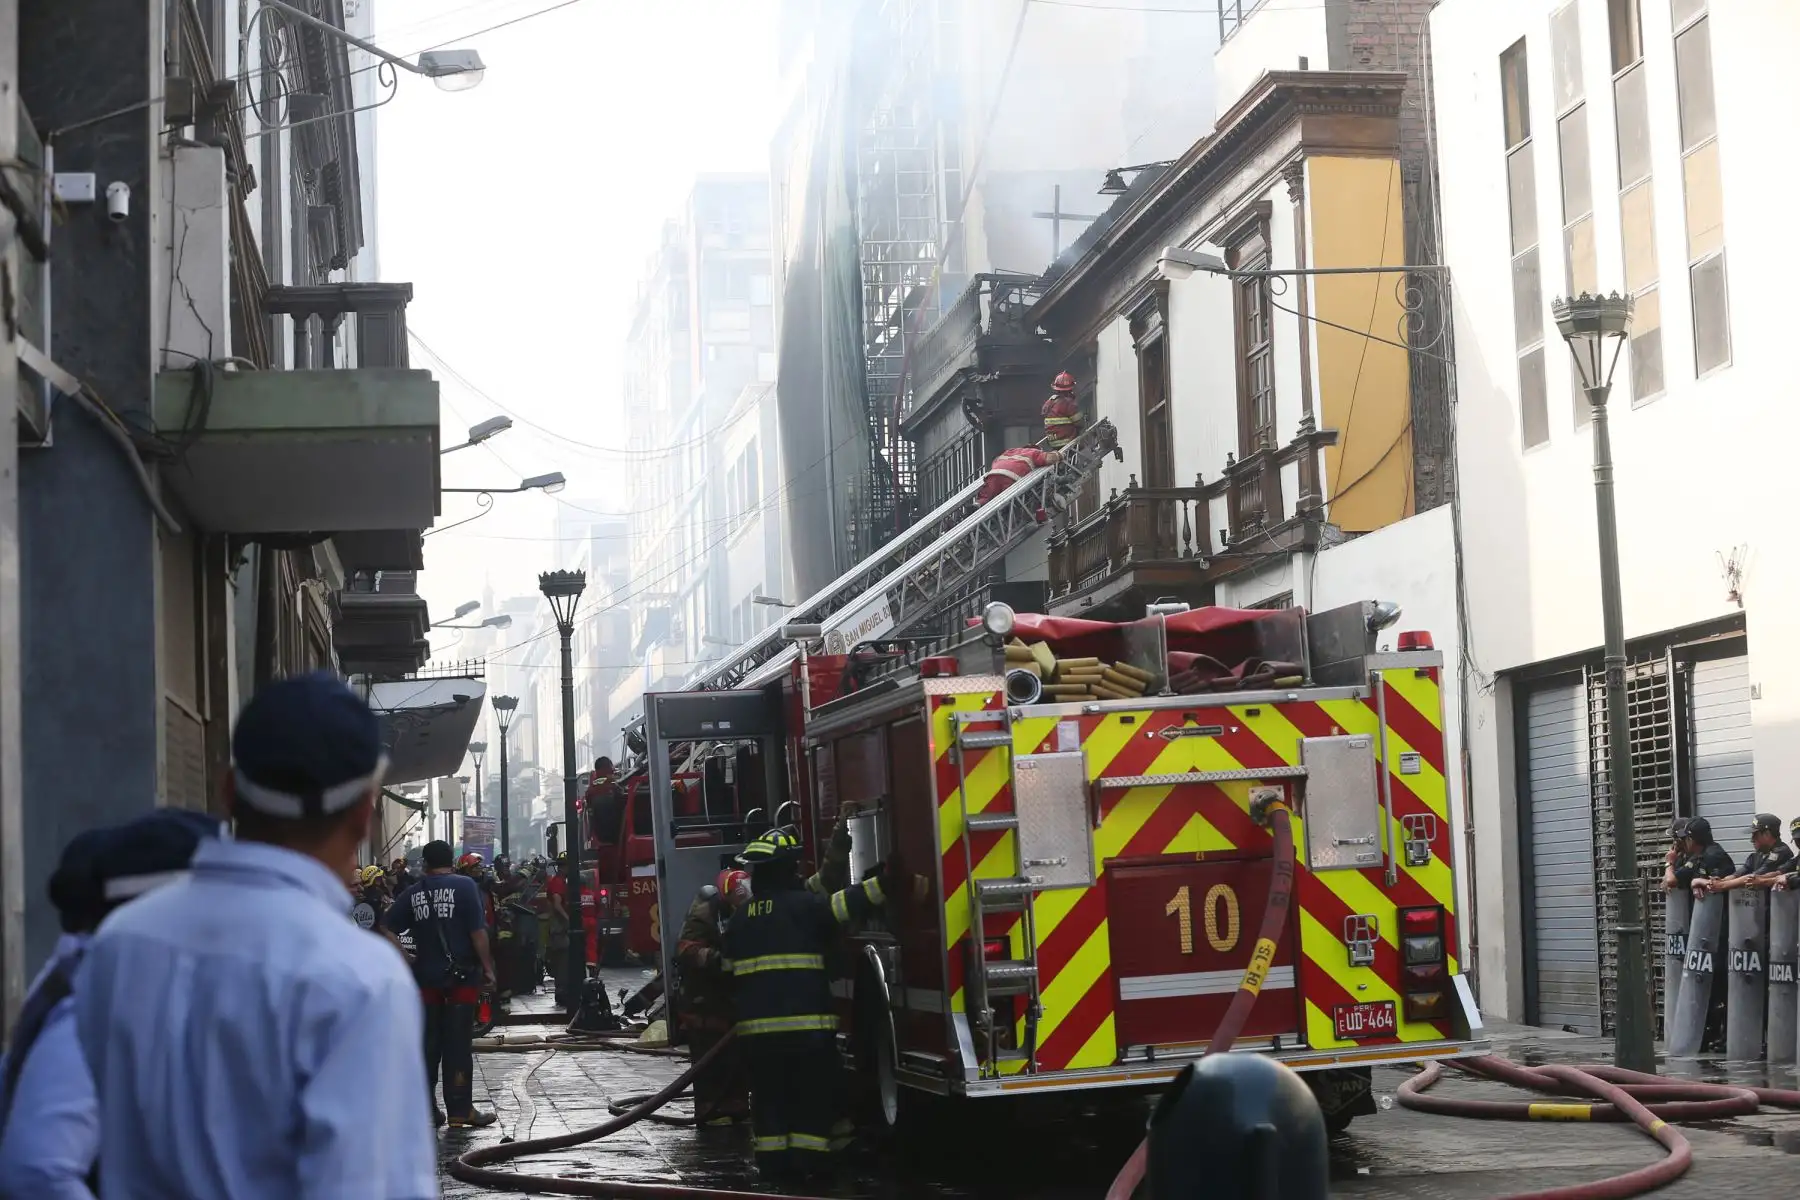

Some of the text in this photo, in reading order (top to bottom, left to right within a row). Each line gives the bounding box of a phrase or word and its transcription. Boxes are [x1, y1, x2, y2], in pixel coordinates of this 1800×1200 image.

[845, 628, 860, 647] SAN
[858, 611, 884, 637] MIGUEL
[411, 888, 455, 908] KEE BACK
[748, 900, 773, 917] MFD
[1166, 883, 1240, 954] 10
[1353, 1004, 1376, 1012] PERU
